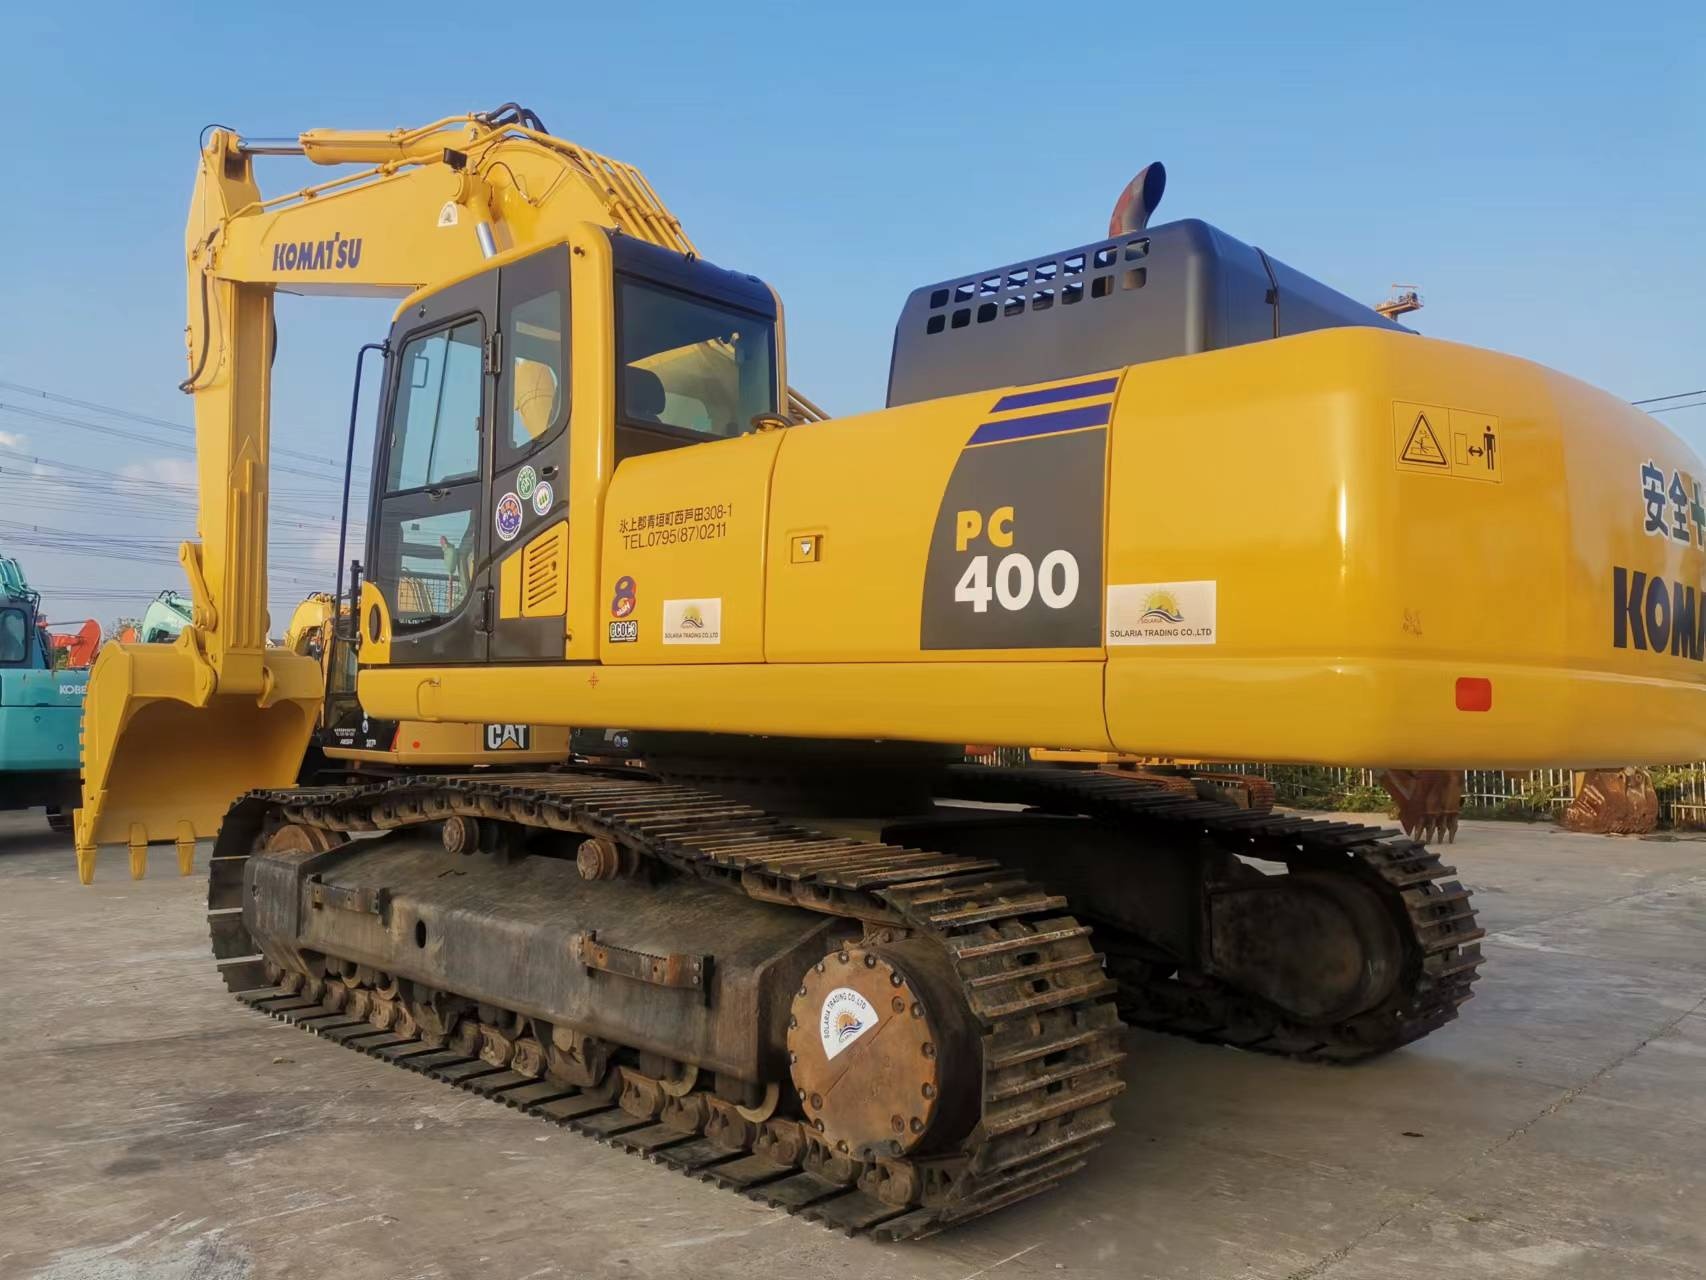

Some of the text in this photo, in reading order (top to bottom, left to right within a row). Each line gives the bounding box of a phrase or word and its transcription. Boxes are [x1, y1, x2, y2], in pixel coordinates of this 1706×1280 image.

[272, 231, 362, 272] KOMATSU
[623, 522, 727, 550] TEL.0795(87)0211
[956, 506, 1015, 552] PC
[954, 549, 1080, 613] 400
[1110, 629, 1142, 638] SOLARIA
[1144, 628, 1179, 637] TRADING
[487, 724, 527, 750] CAT
